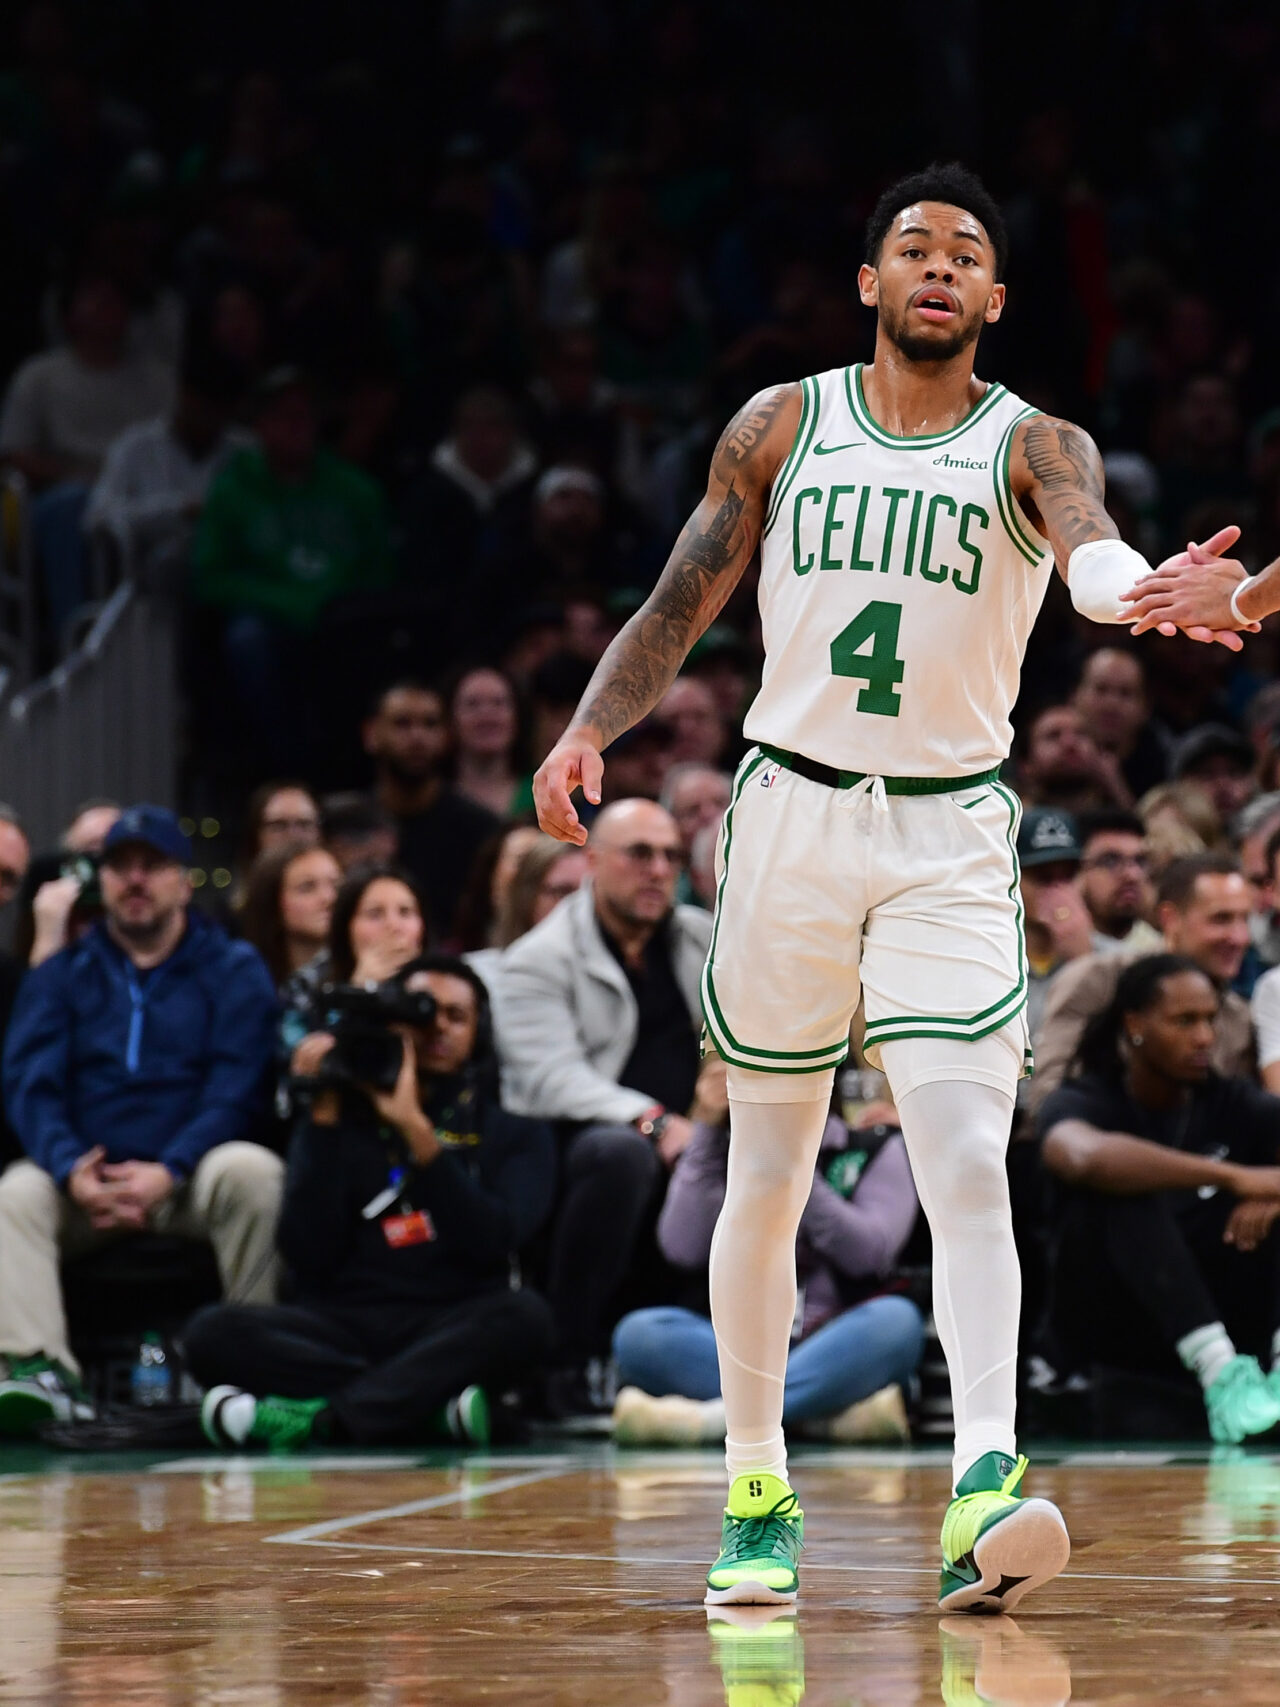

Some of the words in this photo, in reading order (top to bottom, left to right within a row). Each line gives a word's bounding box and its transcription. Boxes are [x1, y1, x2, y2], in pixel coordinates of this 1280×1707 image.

[932, 453, 989, 470] Amica
[793, 485, 990, 595] CELTICS
[830, 600, 905, 717] 4
